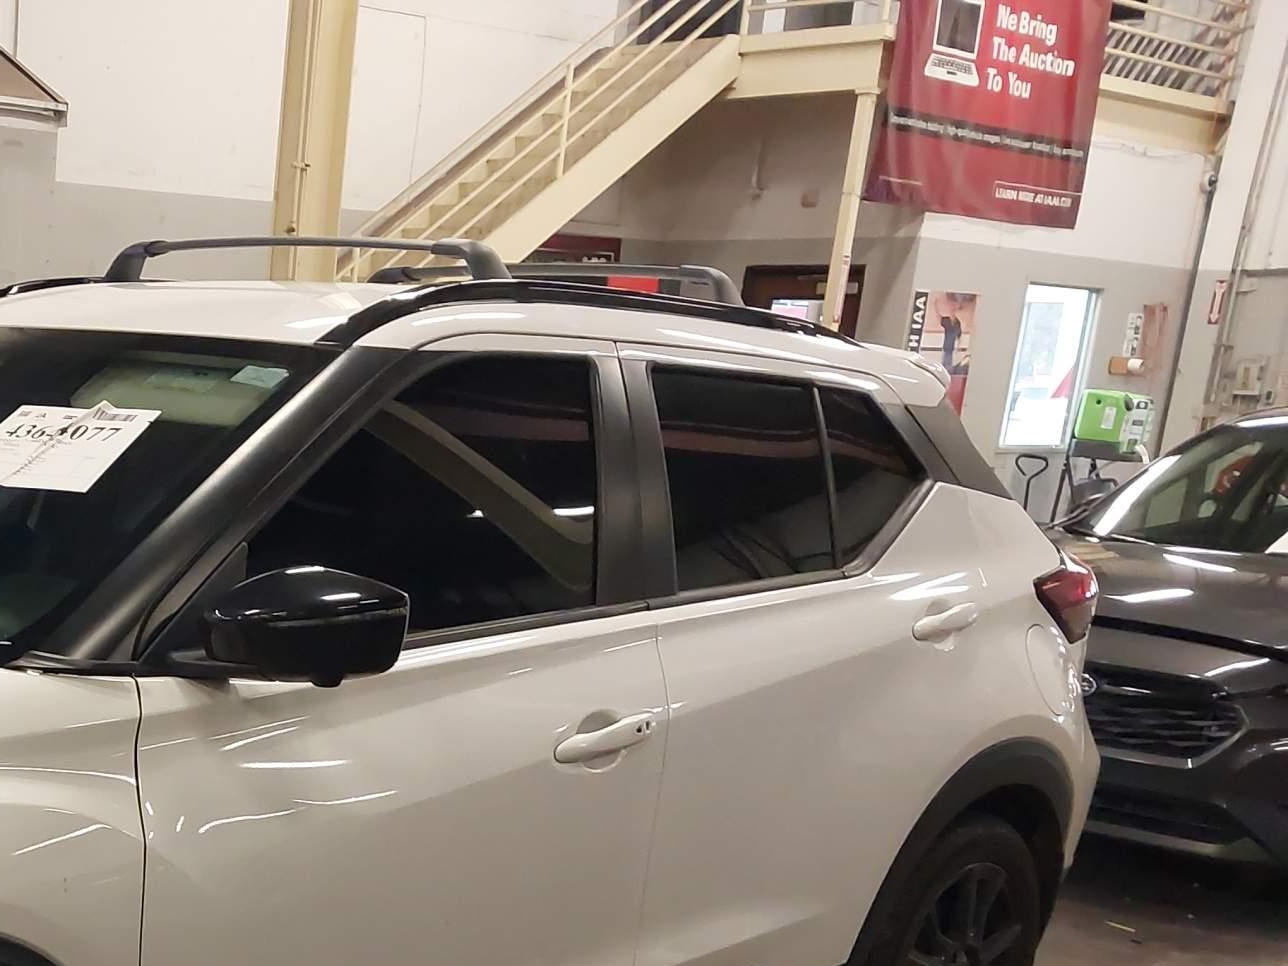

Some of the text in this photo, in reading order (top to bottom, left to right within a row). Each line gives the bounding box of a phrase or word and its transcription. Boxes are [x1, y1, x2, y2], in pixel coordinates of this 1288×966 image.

[1019, 11, 1058, 46] Bring
[993, 37, 1075, 77] The Auction
[987, 68, 1032, 99] To You
[912, 296, 926, 329] IAA
